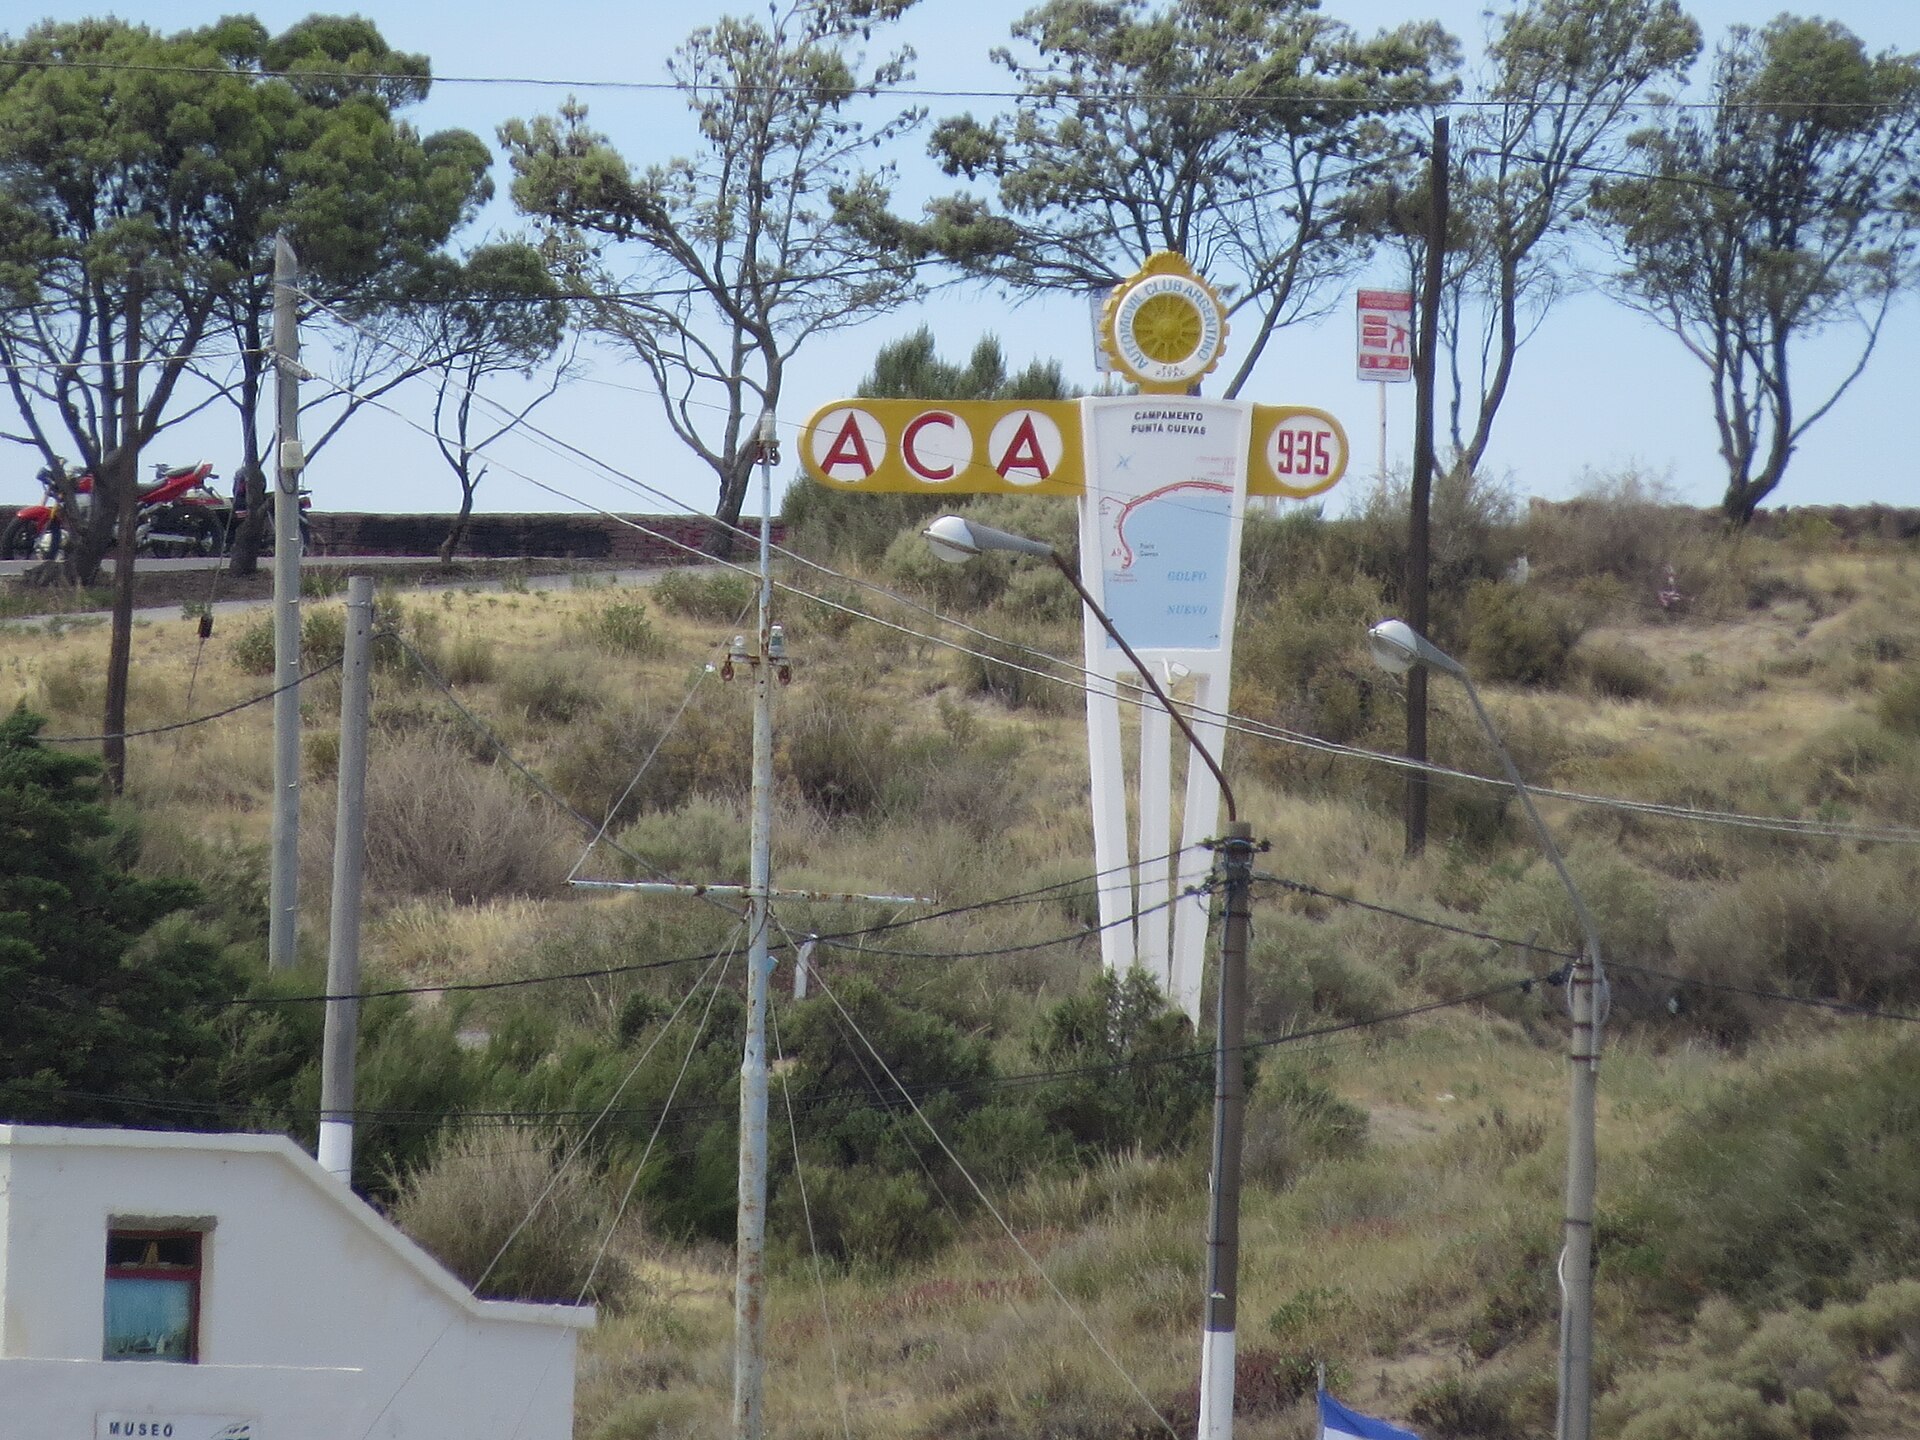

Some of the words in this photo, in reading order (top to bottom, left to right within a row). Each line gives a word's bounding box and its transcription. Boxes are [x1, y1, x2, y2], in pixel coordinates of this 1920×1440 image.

[1145, 279, 1182, 296] CLUB
[1134, 411, 1204, 422] CAMPAMENTO
[1131, 423, 1164, 434] PUNTA
[1167, 424, 1206, 435] CUEVAS
[1278, 430, 1331, 476] 935
[1167, 571, 1207, 582] GOLFO
[1167, 605, 1208, 616] NUEVO
[109, 1421, 173, 1438] MUSEO
